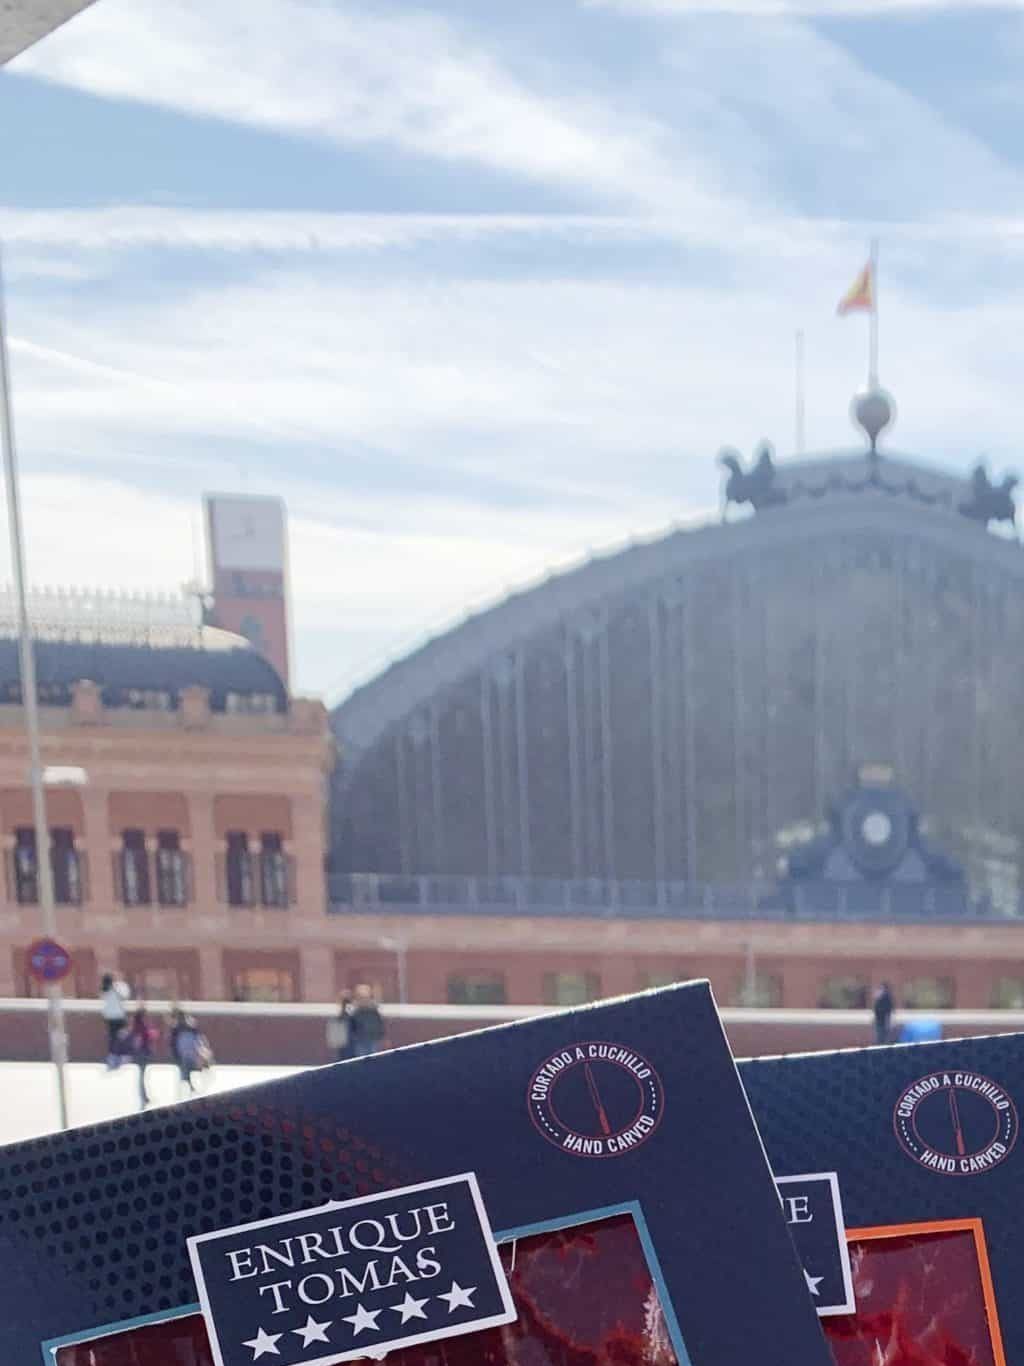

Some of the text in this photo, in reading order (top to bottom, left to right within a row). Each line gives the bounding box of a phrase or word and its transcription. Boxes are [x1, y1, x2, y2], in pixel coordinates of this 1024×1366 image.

[531, 1045, 651, 1100] CORTADO A CUCHILLO
[898, 1074, 1010, 1117] CORTADO A CUCHILLO
[563, 1115, 655, 1154] HAND CARVED
[920, 1142, 1006, 1172] HAND CARVED
[224, 1202, 456, 1282] ENRIQUE
[259, 1247, 442, 1315] TOMAS
